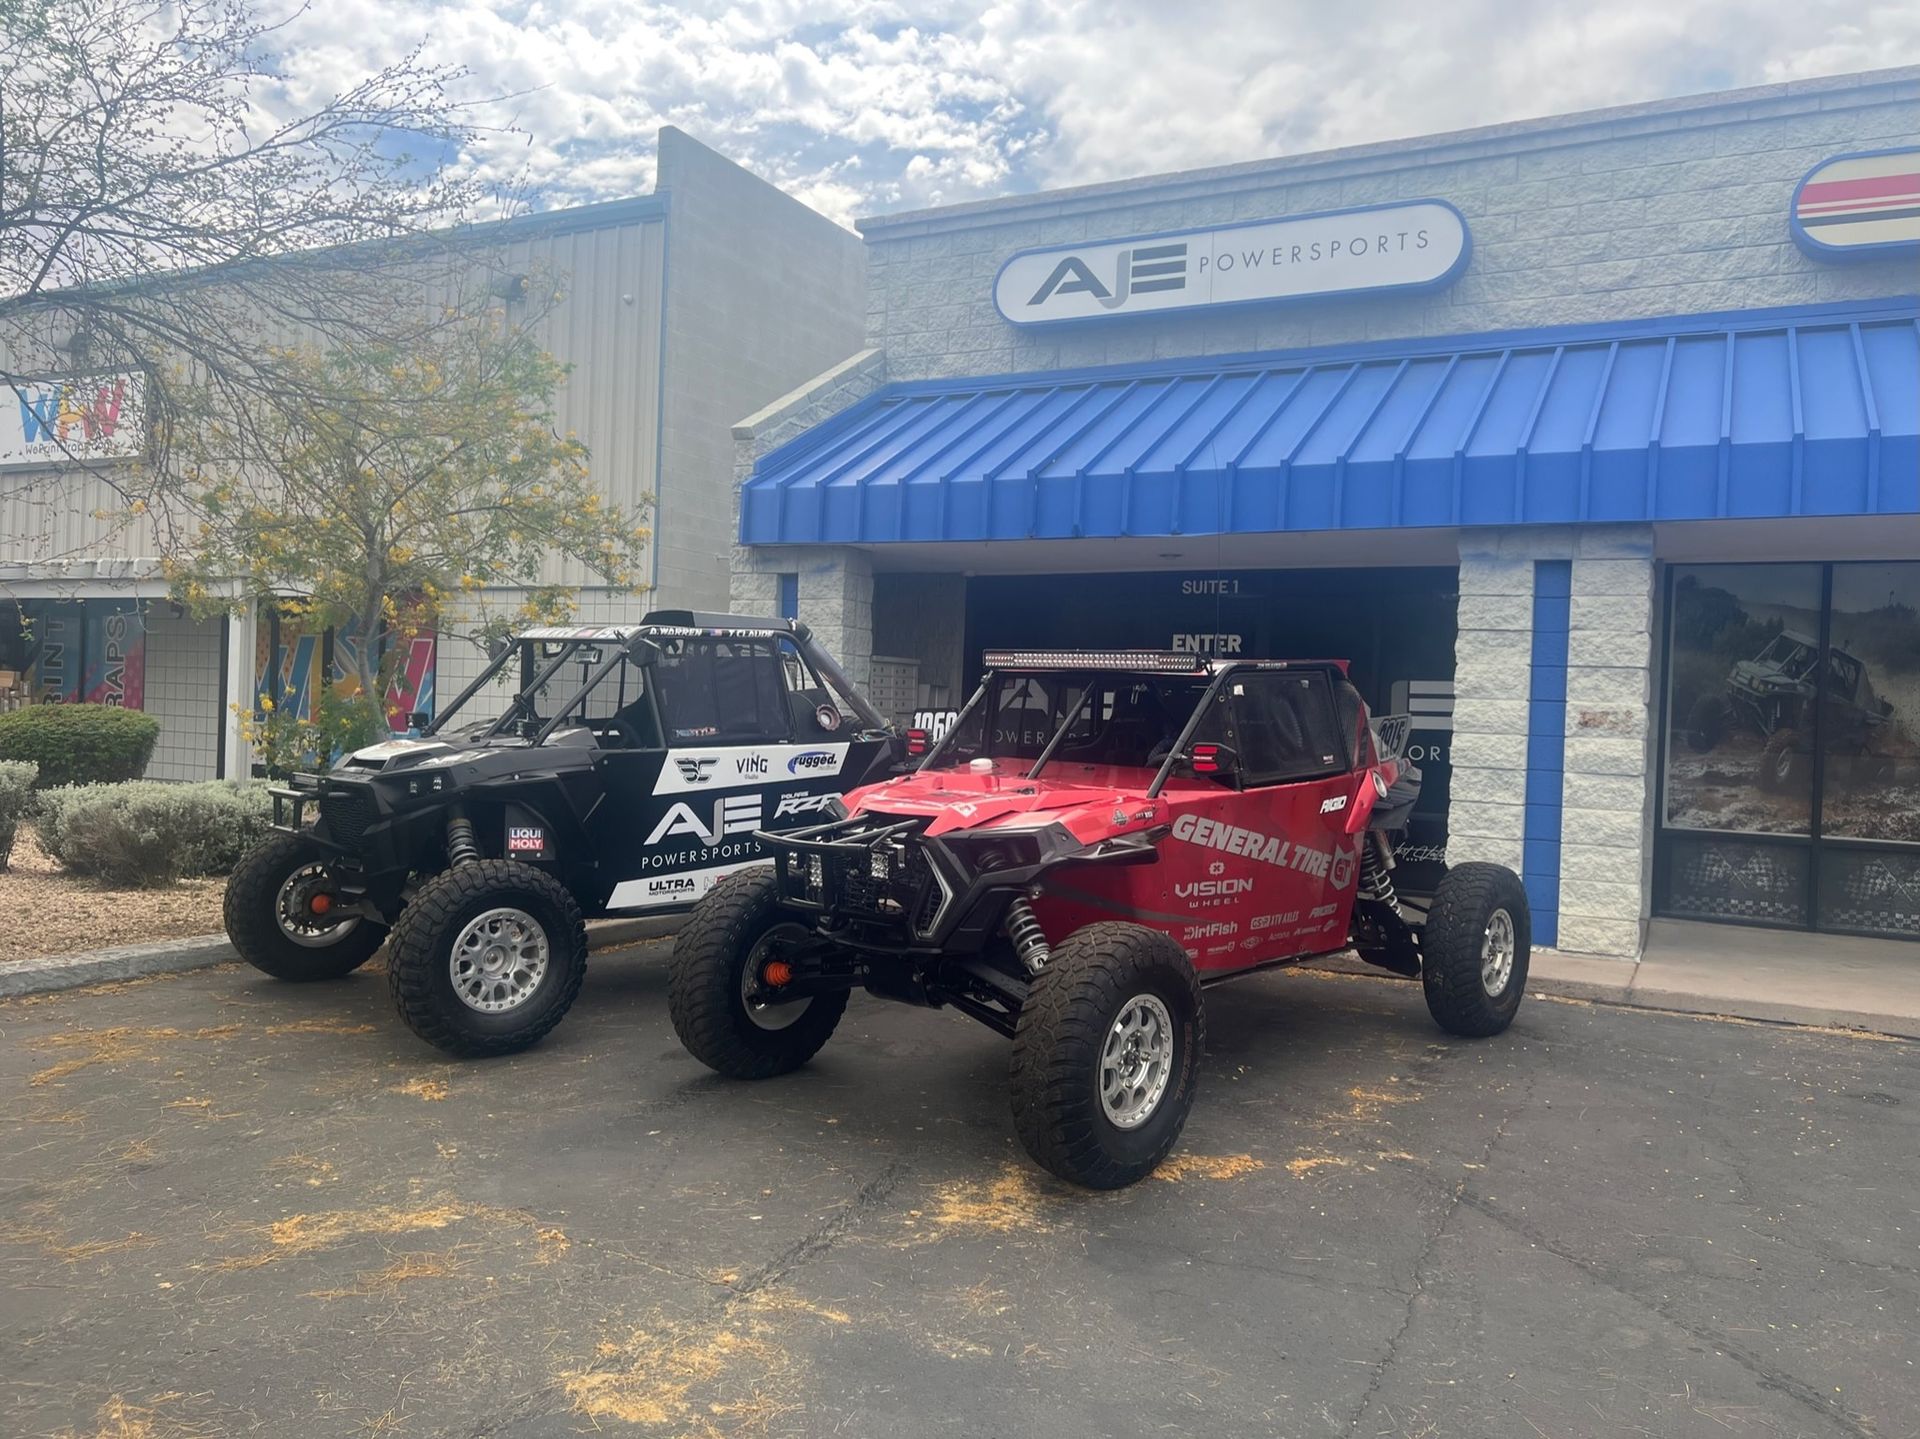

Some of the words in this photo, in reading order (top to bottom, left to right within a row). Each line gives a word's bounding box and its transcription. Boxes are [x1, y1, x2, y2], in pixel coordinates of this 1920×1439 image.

[1026, 243, 1188, 310] AJE
[1199, 229, 1430, 274] POWERSPORTS
[1182, 580, 1229, 594] SUITE
[1233, 580, 1239, 594] 1
[1172, 634, 1242, 653] ENTER
[736, 755, 768, 773] VING
[644, 794, 762, 847] AJE
[511, 828, 542, 839] LIQUI
[511, 839, 541, 849] MOLY
[1172, 813, 1292, 867] GENERAL
[1290, 845, 1333, 878] TIRE
[641, 841, 762, 869] POWERSPORTS
[648, 878, 695, 891] ULTRA
[1175, 878, 1253, 898] VISION
[1189, 896, 1240, 908] WHEEL
[1184, 921, 1238, 940] DirtFish
